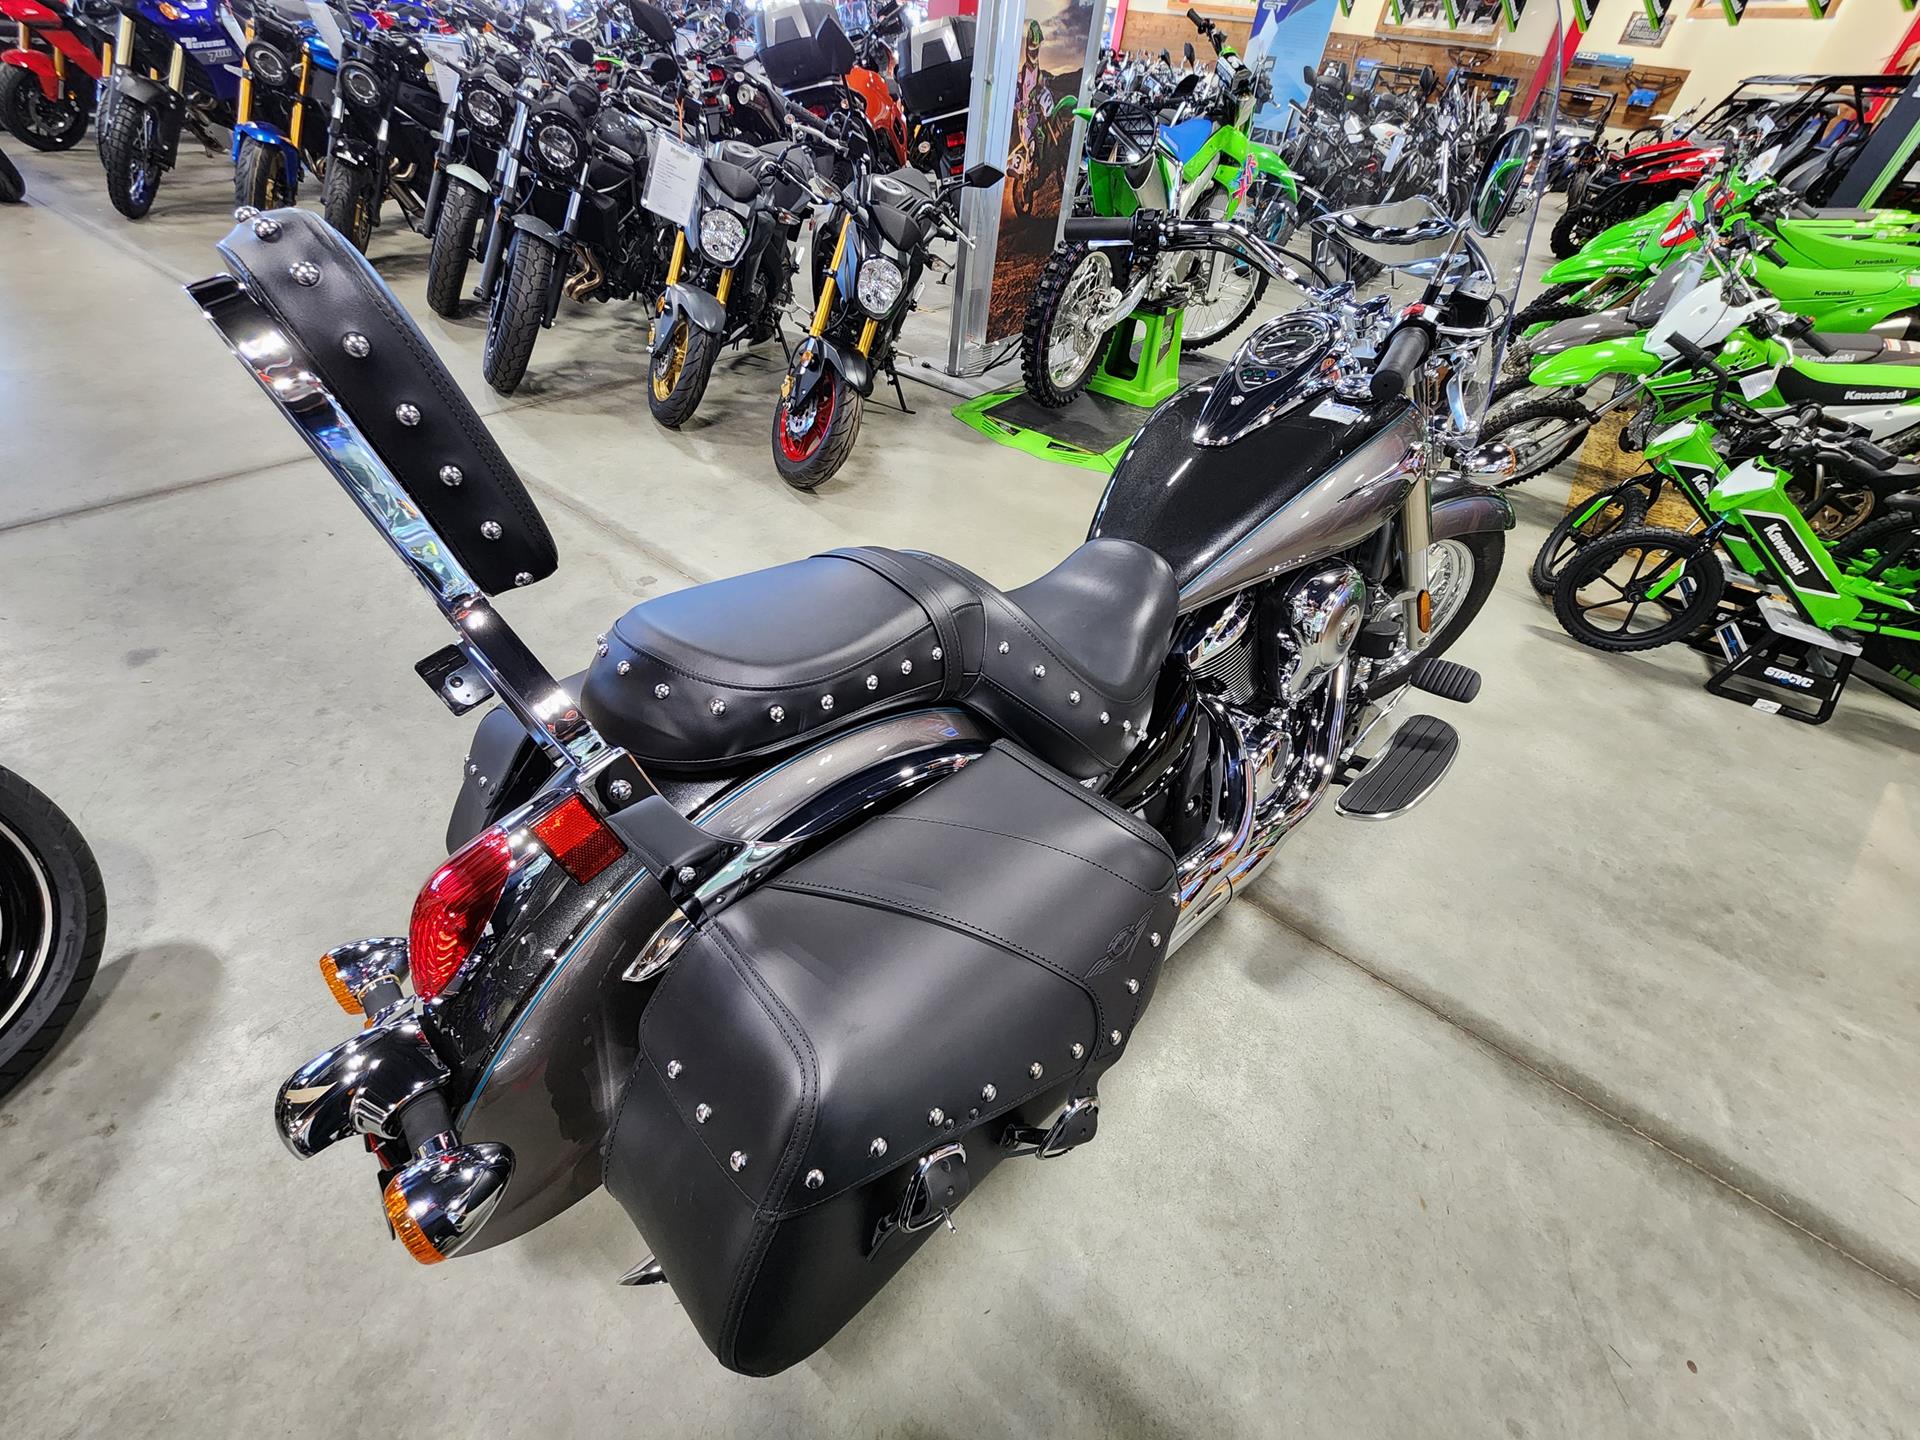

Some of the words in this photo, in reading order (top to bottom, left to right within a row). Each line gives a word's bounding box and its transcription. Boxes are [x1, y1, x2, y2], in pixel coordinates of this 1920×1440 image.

[1013, 155, 1021, 169] 3
[1844, 390, 1907, 400] Kawasaki
[1763, 522, 1809, 576] Kawasaki
[1764, 667, 1815, 688] STACYC
